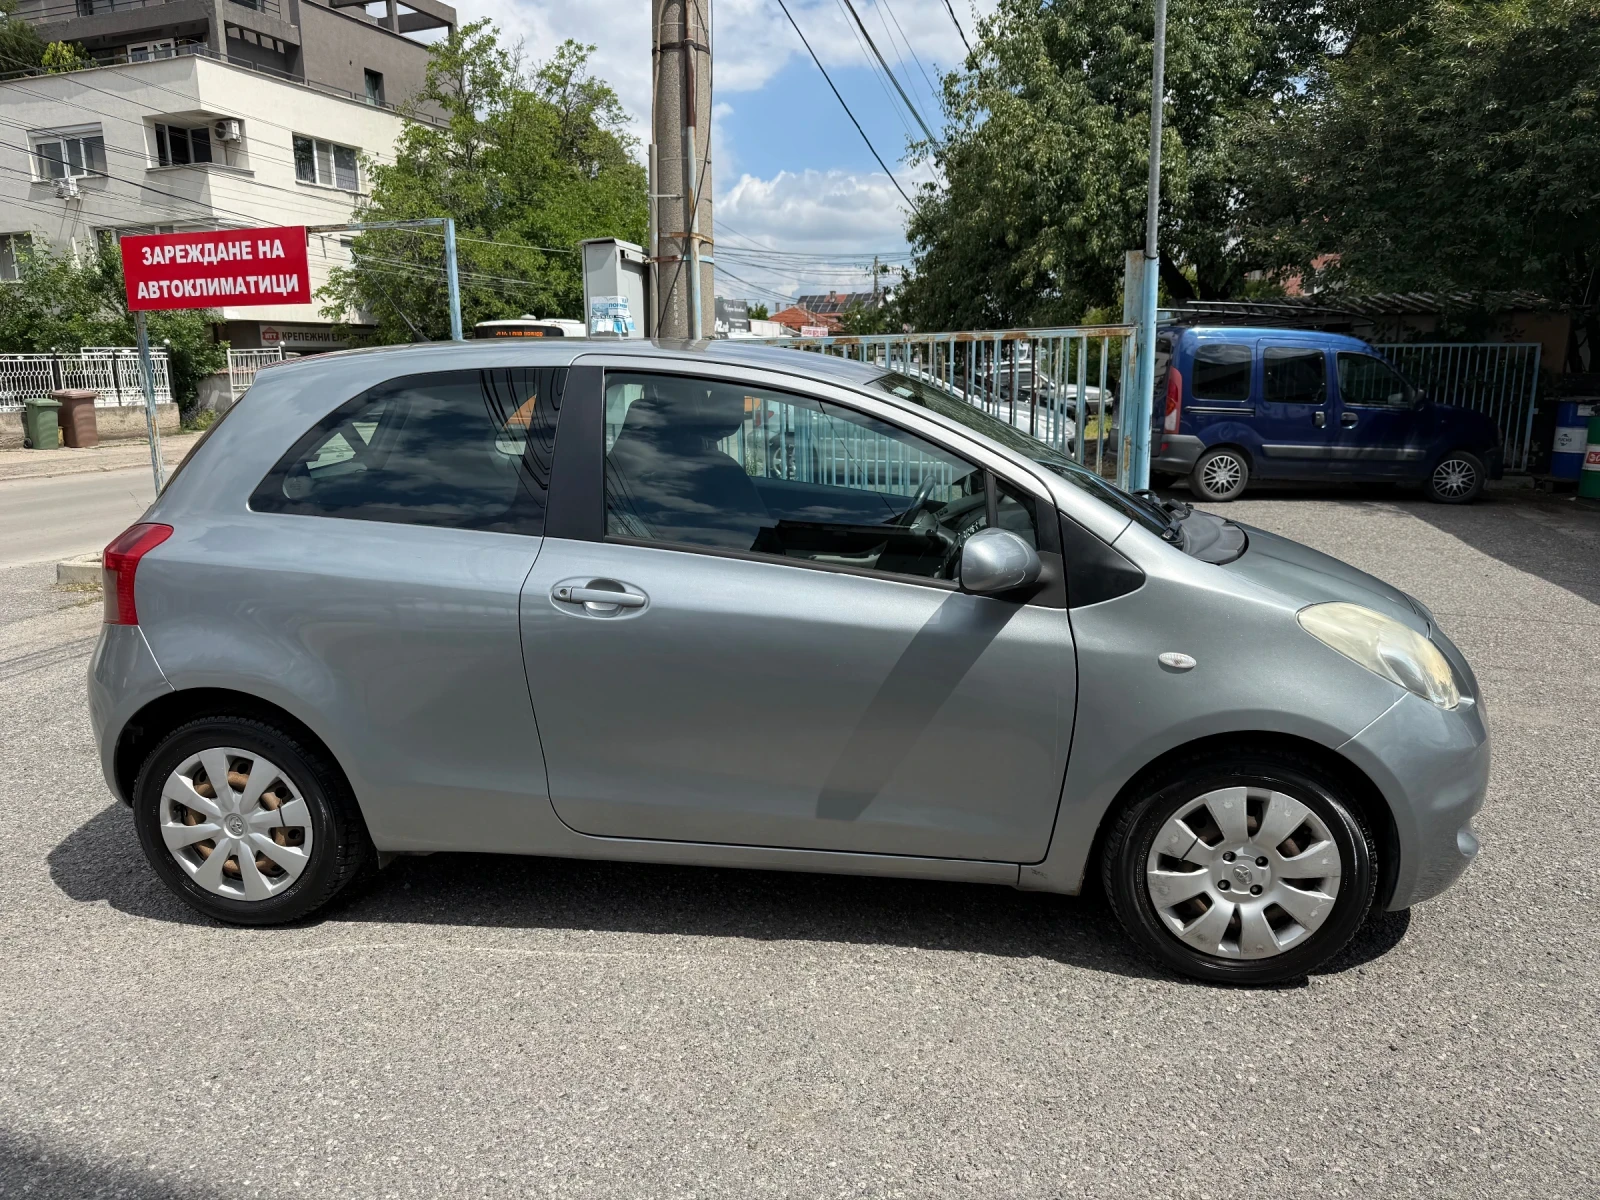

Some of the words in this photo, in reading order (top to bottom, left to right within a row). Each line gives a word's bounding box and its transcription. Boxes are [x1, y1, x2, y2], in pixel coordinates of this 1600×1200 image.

[141, 240, 253, 266] ЗАРЕЖДАНЕ
[257, 239, 285, 259] НА
[137, 274, 299, 300] АВТОКЛИМАТИЦИ
[281, 331, 330, 341] КРЕПЕЖНИ
